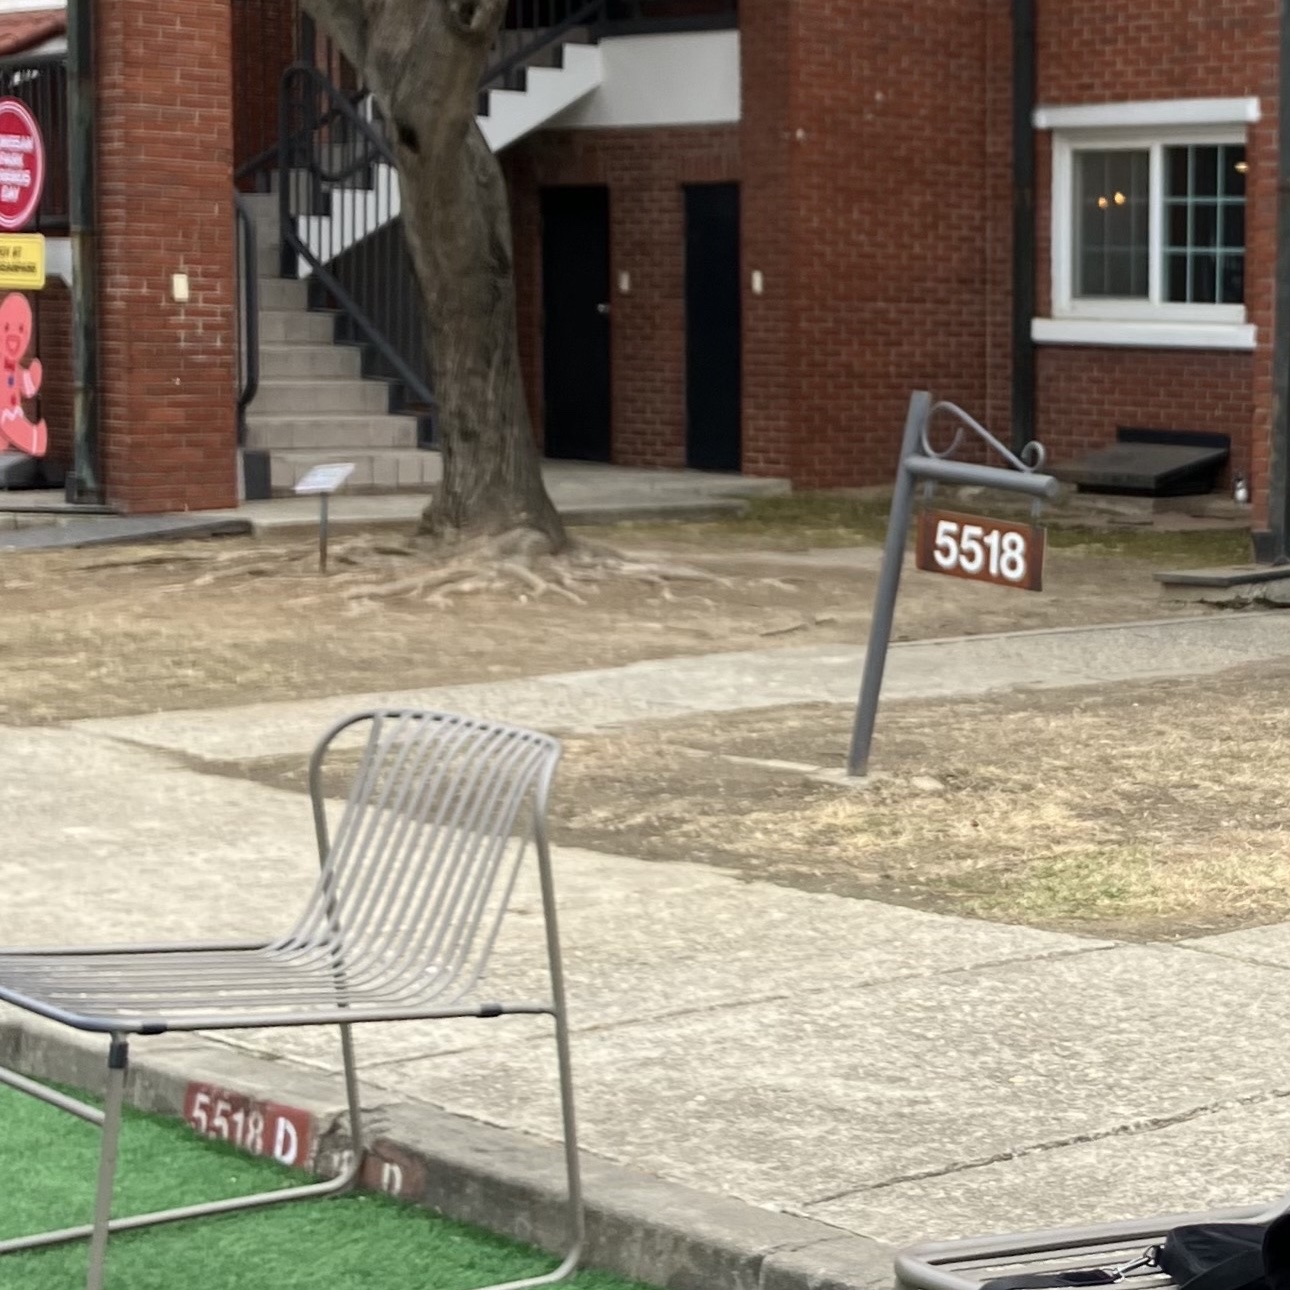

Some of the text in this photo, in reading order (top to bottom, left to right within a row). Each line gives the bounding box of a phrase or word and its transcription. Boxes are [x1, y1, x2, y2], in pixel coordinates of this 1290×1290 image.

[933, 520, 1026, 580] 5518
[191, 1092, 264, 1154] 5518
[273, 1116, 298, 1166] D
